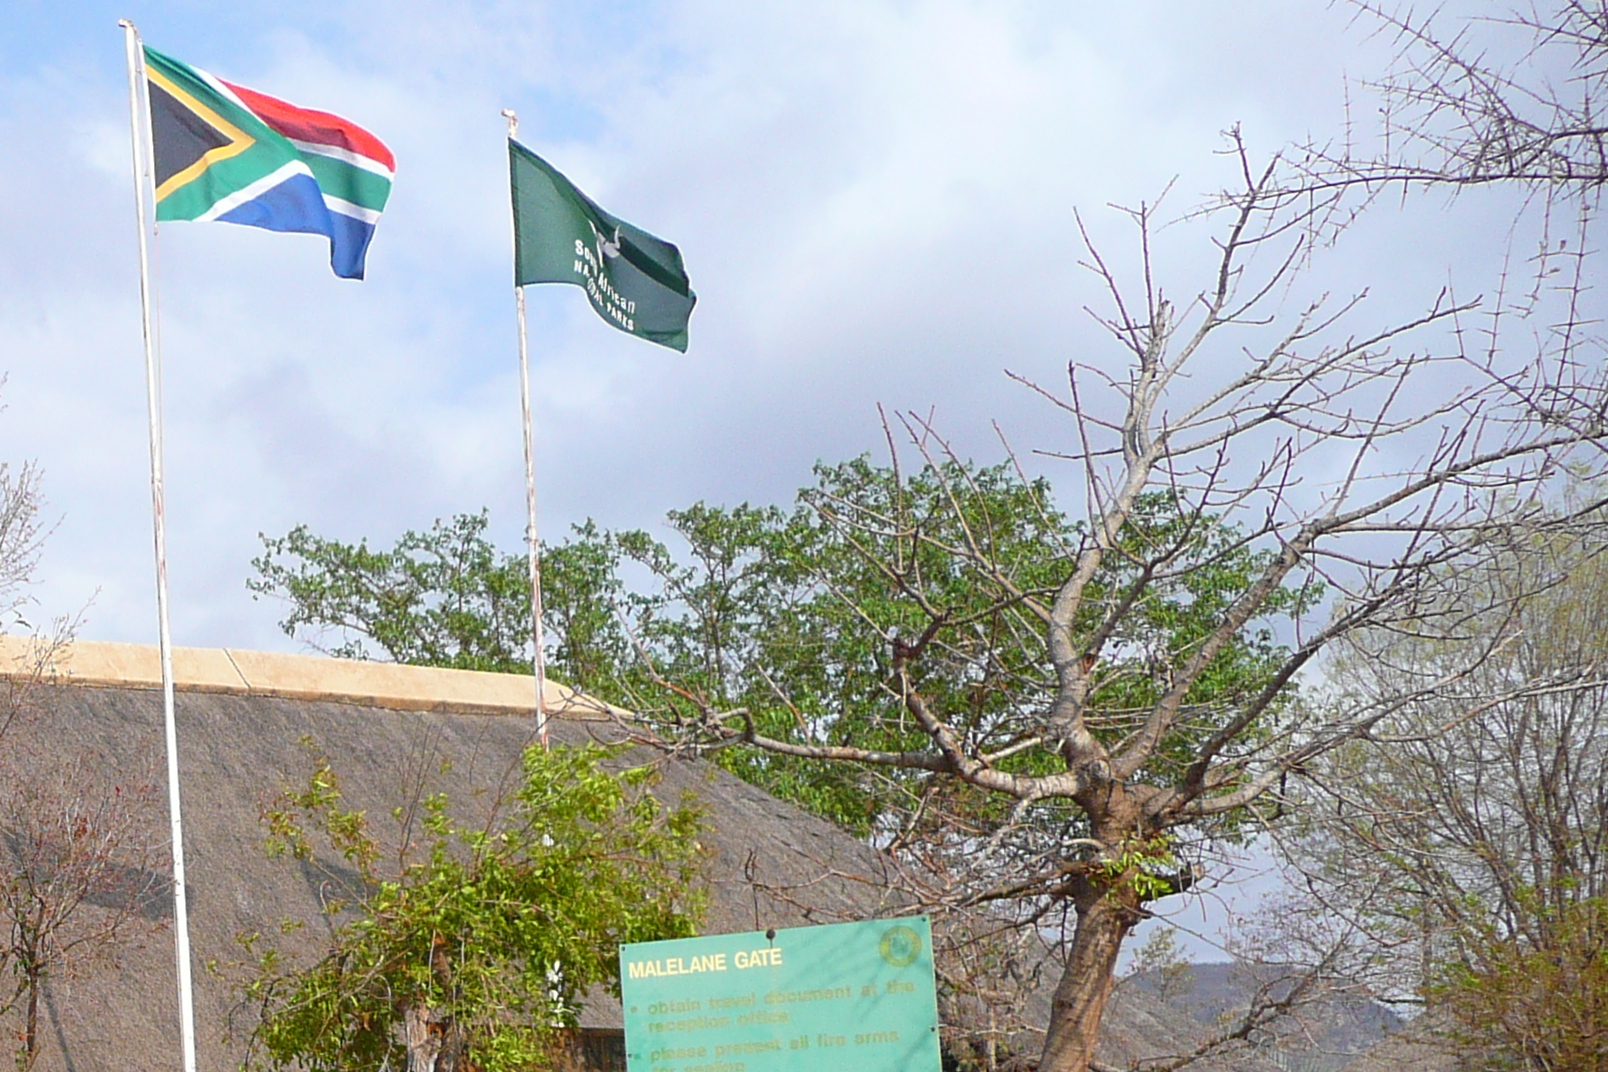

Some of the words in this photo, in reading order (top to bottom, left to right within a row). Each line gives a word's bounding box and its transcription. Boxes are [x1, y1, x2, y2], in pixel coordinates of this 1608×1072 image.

[605, 302, 634, 331] PARKS
[629, 953, 727, 979] MALELANE
[734, 947, 783, 969] GATE
[647, 997, 701, 1015] obtain
[708, 993, 756, 1010] travel
[764, 985, 852, 1005] document
[860, 982, 878, 997] at
[886, 979, 916, 994] the
[648, 1015, 731, 1033] reception
[737, 1010, 789, 1026] office
[650, 1046, 708, 1063] please
[715, 1038, 782, 1058] present
[789, 1034, 809, 1049] all
[817, 1033, 846, 1047] fire
[854, 1031, 900, 1045] arms
